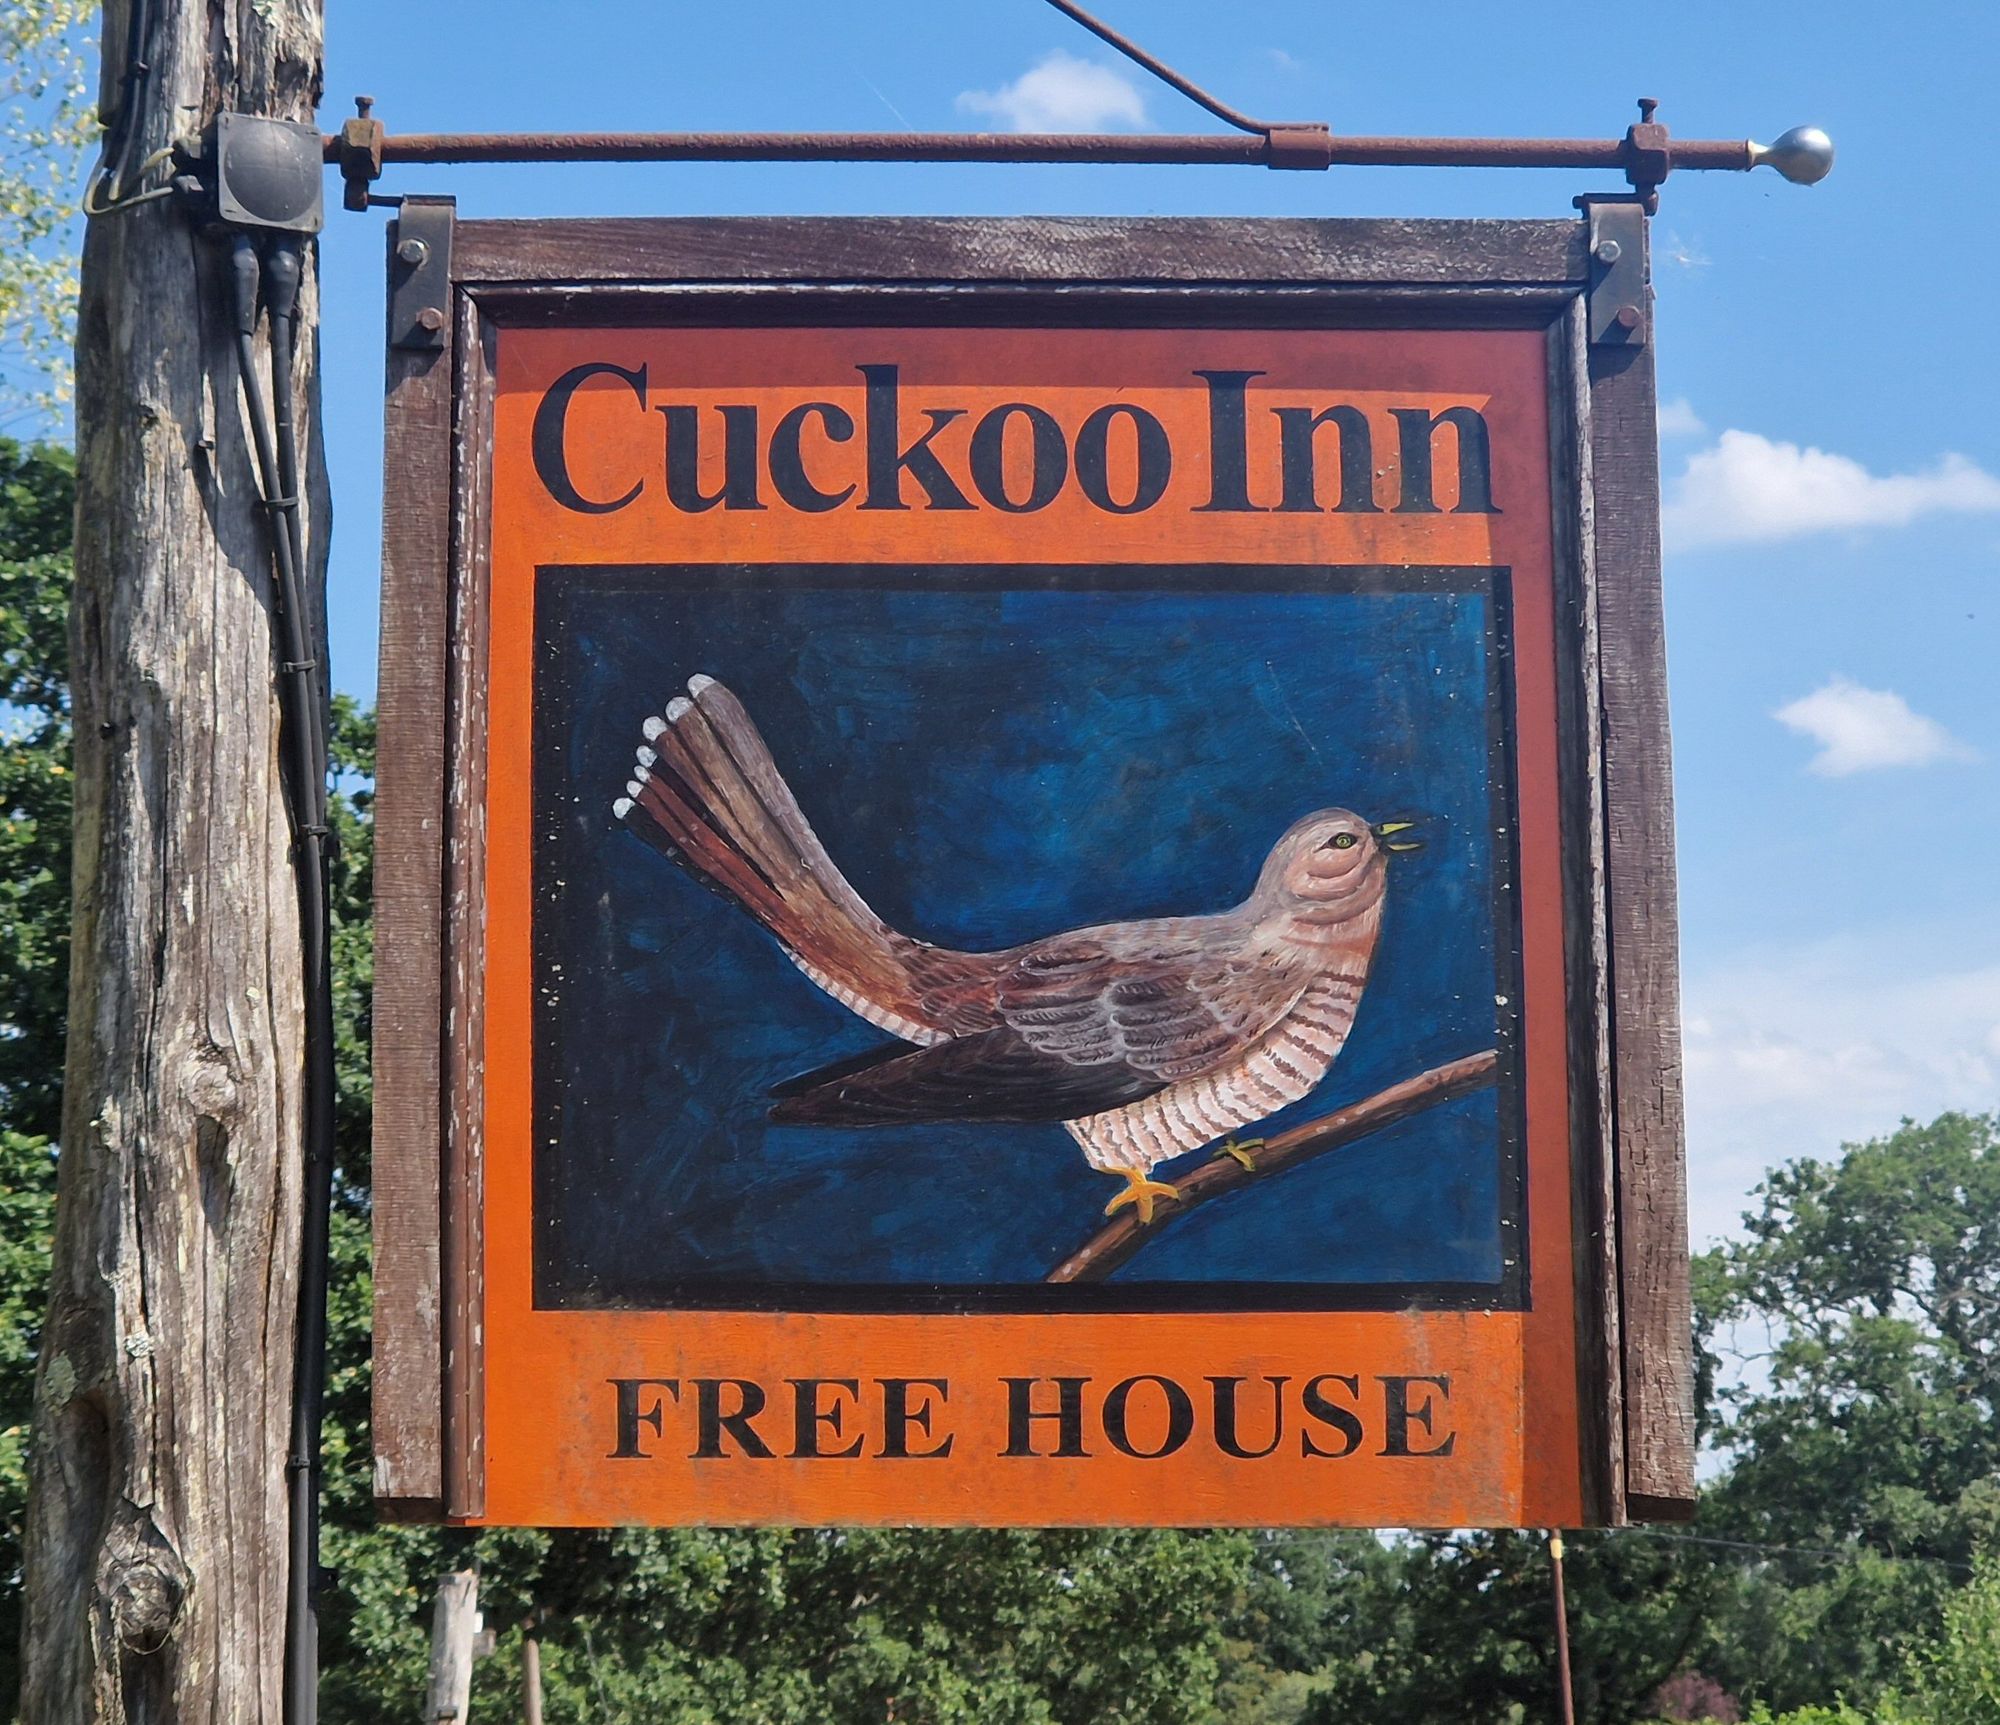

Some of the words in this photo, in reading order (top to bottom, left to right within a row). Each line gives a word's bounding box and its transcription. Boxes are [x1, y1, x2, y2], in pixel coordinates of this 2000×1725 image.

[532, 361, 1173, 515] Cuckoo
[1191, 369, 1506, 515] Inn
[605, 1377, 954, 1459] FREE
[996, 1374, 1457, 1459] HOUSE
